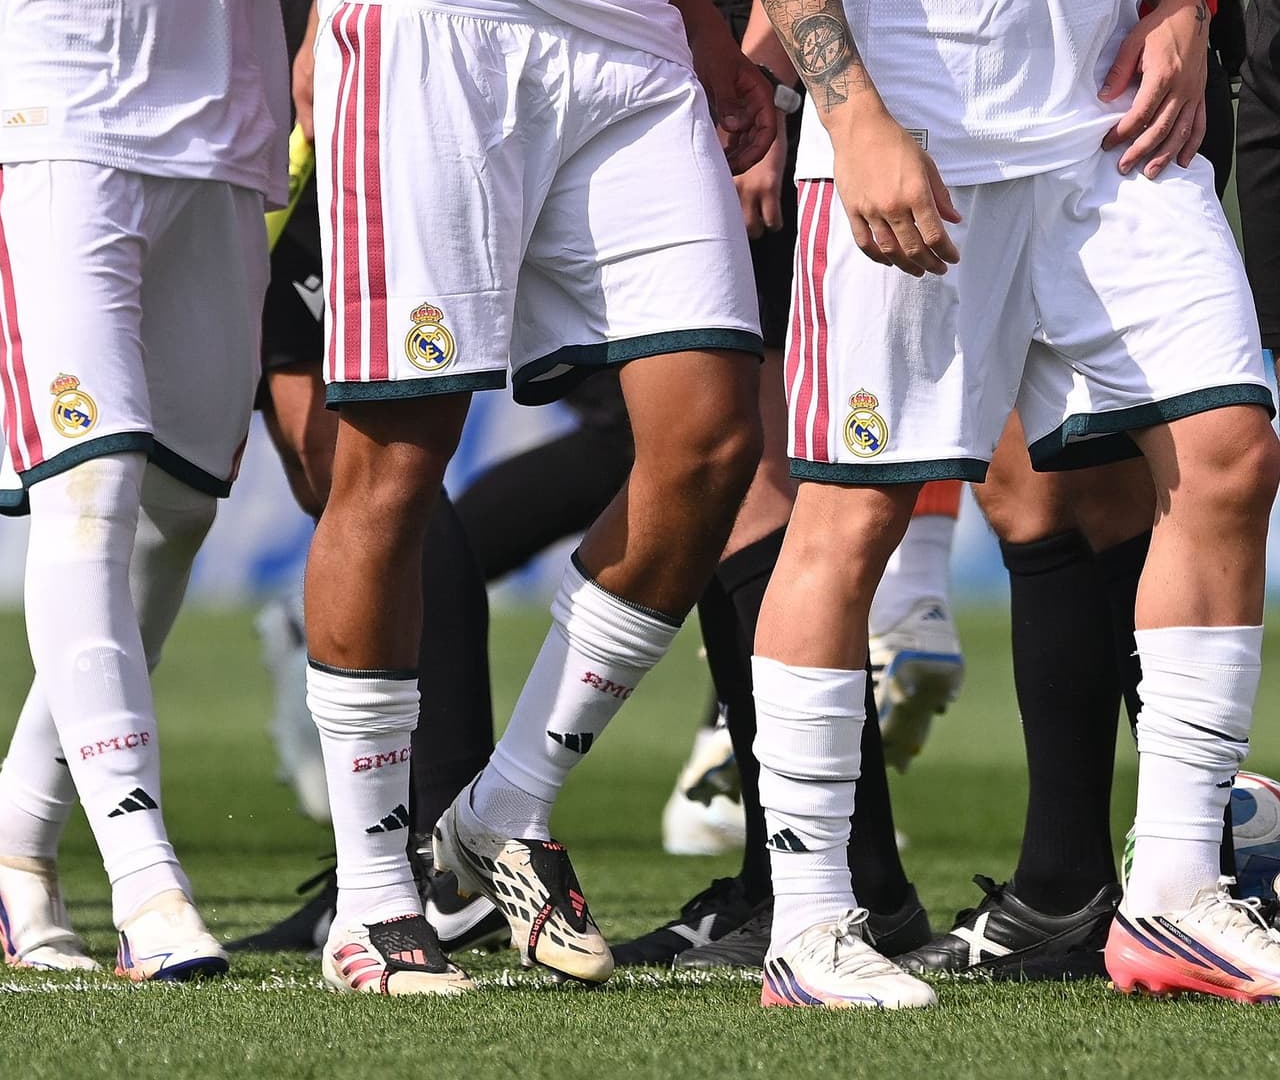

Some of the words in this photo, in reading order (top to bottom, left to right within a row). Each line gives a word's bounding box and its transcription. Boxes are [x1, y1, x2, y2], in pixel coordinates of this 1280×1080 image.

[581, 672, 635, 701] RMC
[80, 731, 150, 761] RMCF
[528, 903, 552, 948] PREDATOR
